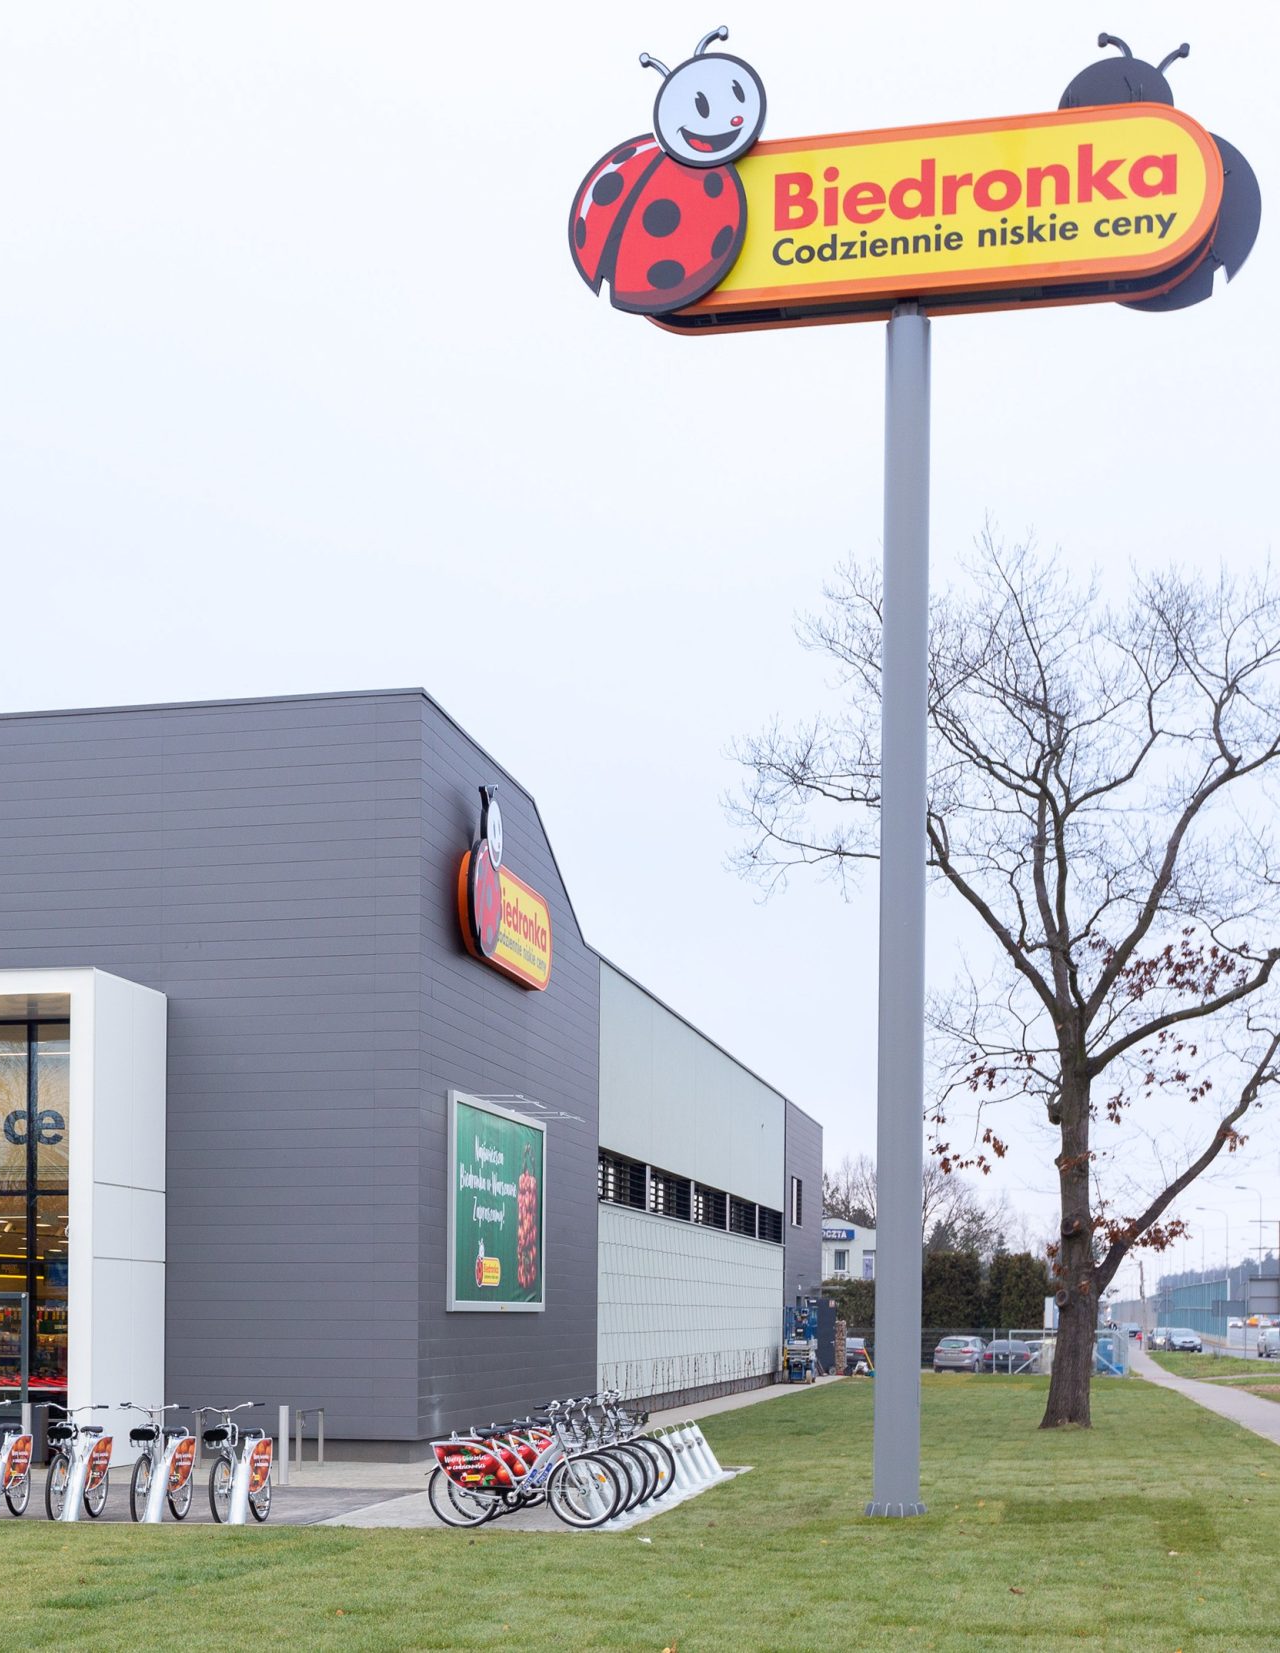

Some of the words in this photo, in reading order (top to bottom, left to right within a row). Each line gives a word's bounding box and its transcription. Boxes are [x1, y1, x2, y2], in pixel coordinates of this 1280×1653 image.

[773, 144, 1177, 231] Biedronka
[772, 223, 963, 266] Codziennie
[978, 206, 1079, 248] niskie
[1094, 211, 1178, 243] ceny
[501, 887, 547, 953] iedronka
[459, 1162, 486, 1192] Biedronka
[491, 1171, 517, 1198] Warszawie
[472, 1196, 505, 1231] Zapraszamy!
[821, 1229, 847, 1239] OCZTA
